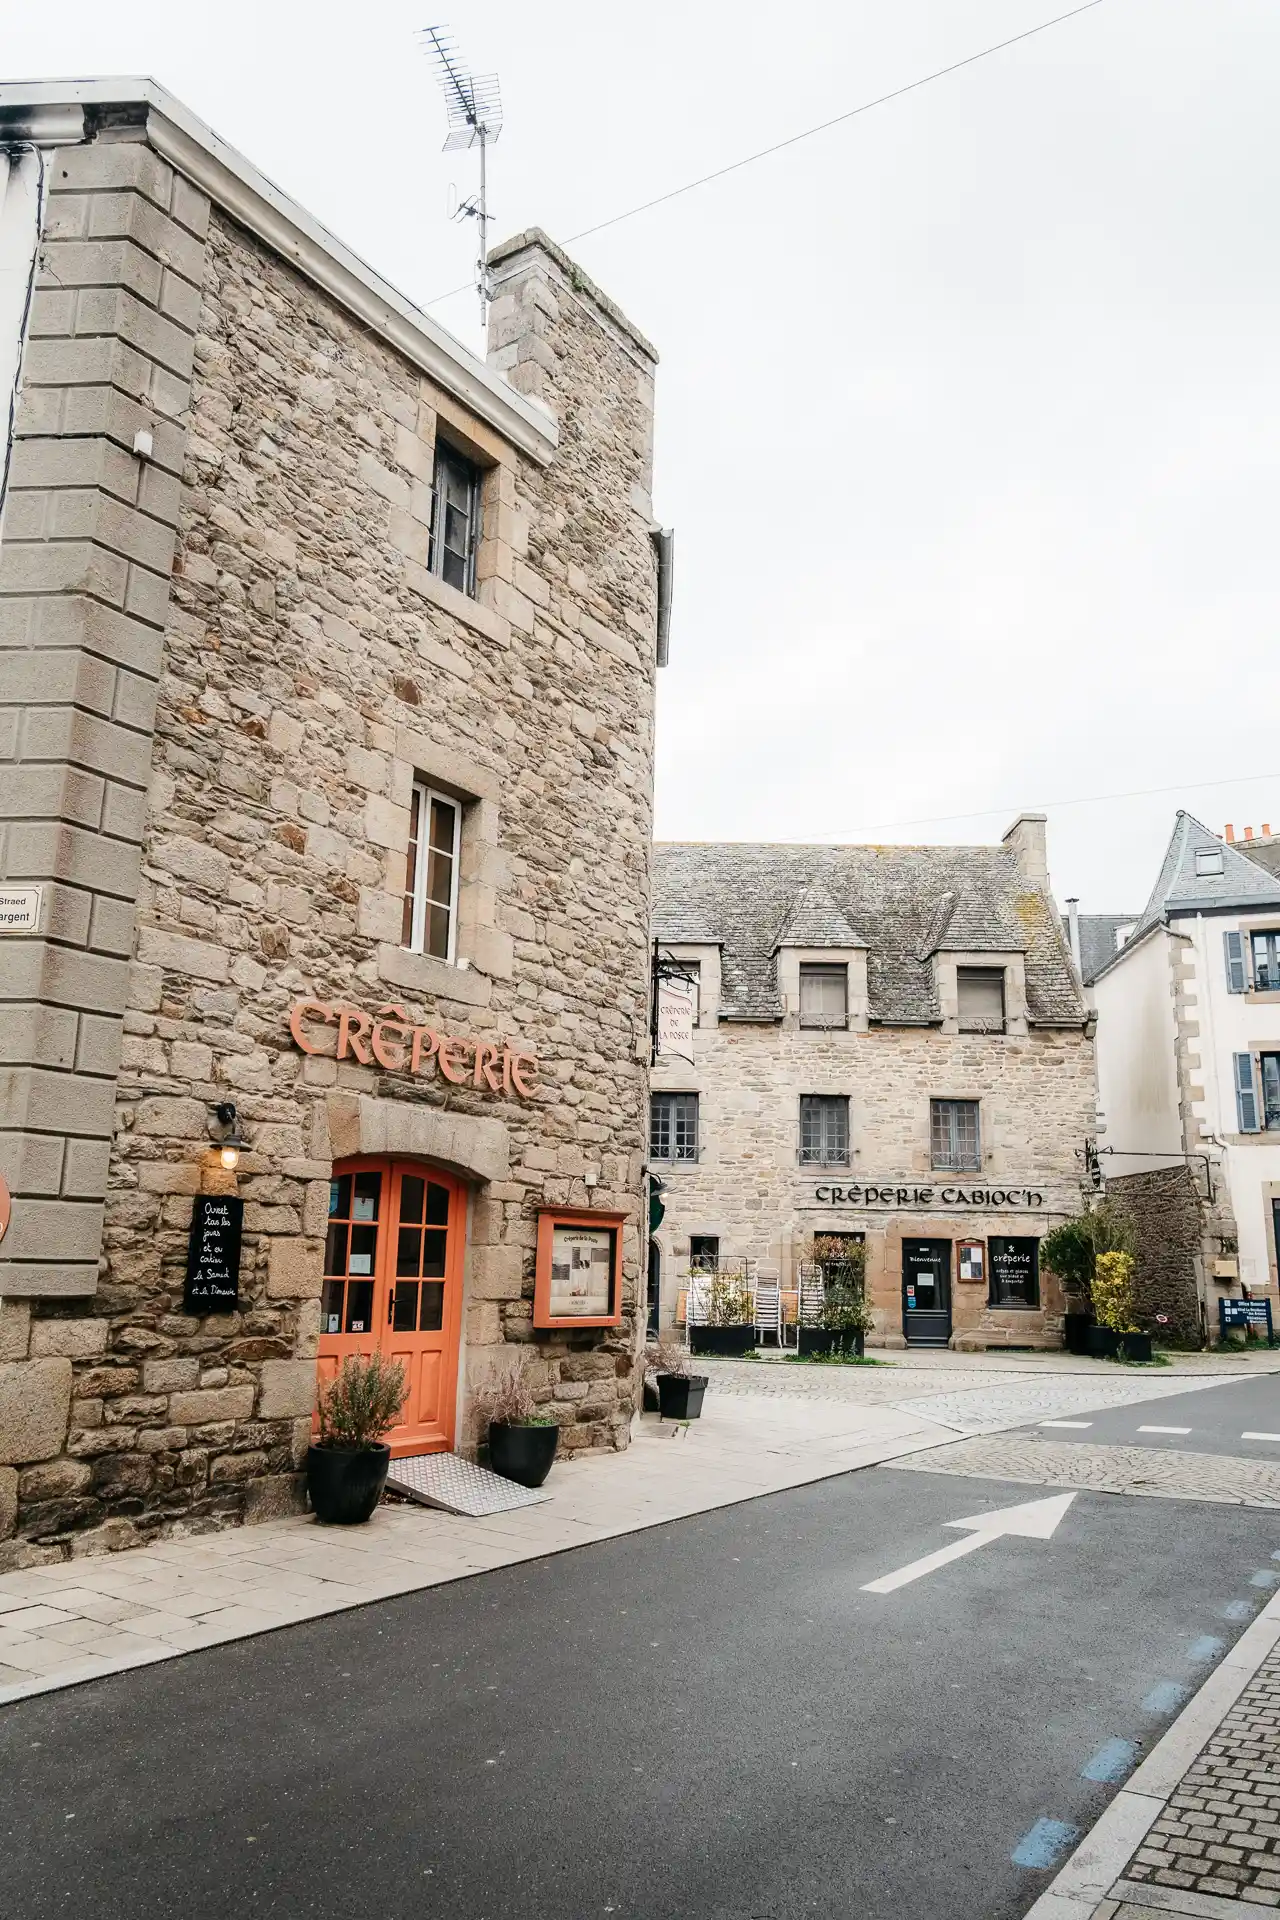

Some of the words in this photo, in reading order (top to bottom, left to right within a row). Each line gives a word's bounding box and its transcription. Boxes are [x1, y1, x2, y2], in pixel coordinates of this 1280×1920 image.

[660, 1005, 691, 1015] CRÊPERIE
[290, 999, 541, 1097] CRÊPERIE
[815, 1184, 935, 1206] CRÊPERIE
[204, 1202, 229, 1215] Ouvert
[203, 1228, 221, 1242] jours
[203, 1242, 212, 1252] et
[993, 1253, 1030, 1265] crêperie
